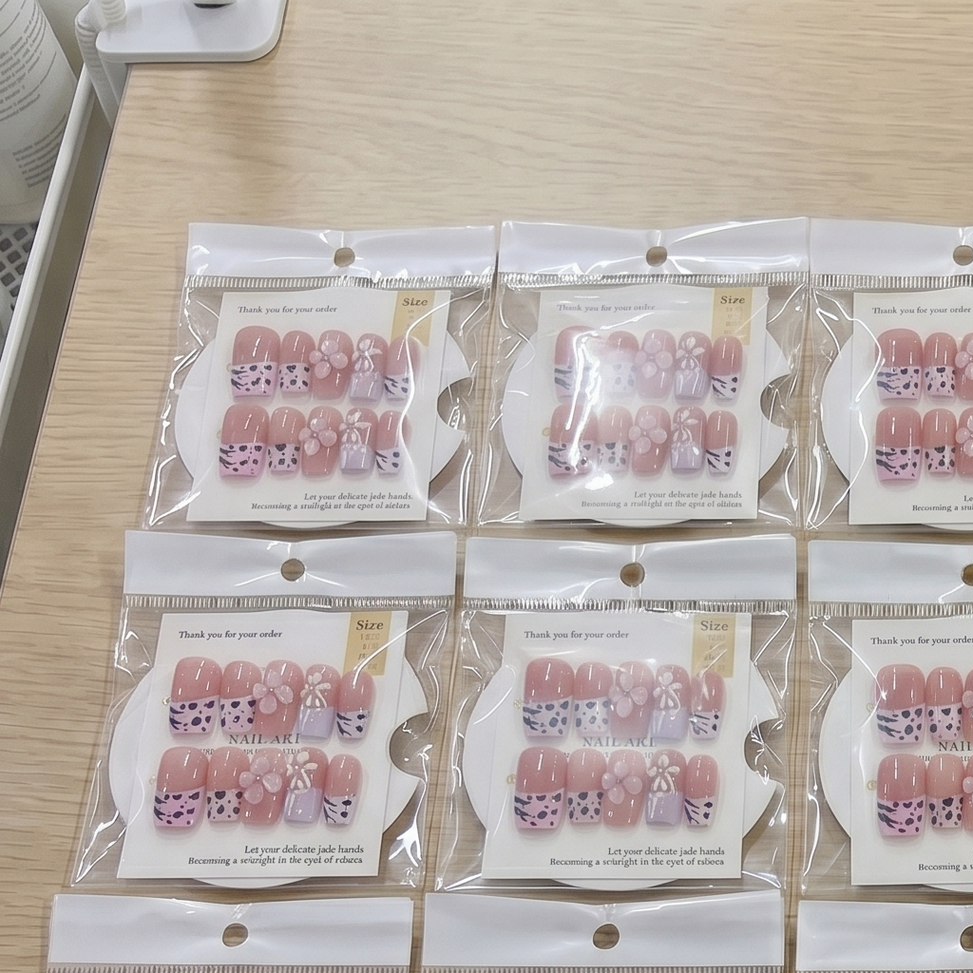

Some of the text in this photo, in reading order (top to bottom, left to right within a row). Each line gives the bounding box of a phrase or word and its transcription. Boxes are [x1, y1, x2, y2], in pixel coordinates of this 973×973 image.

[237, 305, 264, 314] Thank
[264, 308, 281, 316] you
[294, 307, 314, 315] your
[315, 304, 338, 313] order
[356, 619, 384, 631] Size
[700, 620, 729, 632] Size
[178, 629, 283, 642] Thank you for your order
[870, 636, 899, 645] Thank
[900, 638, 916, 647] you
[917, 636, 931, 645] for
[931, 638, 951, 647] your
[607, 846, 726, 858] Let delicate jade hands
